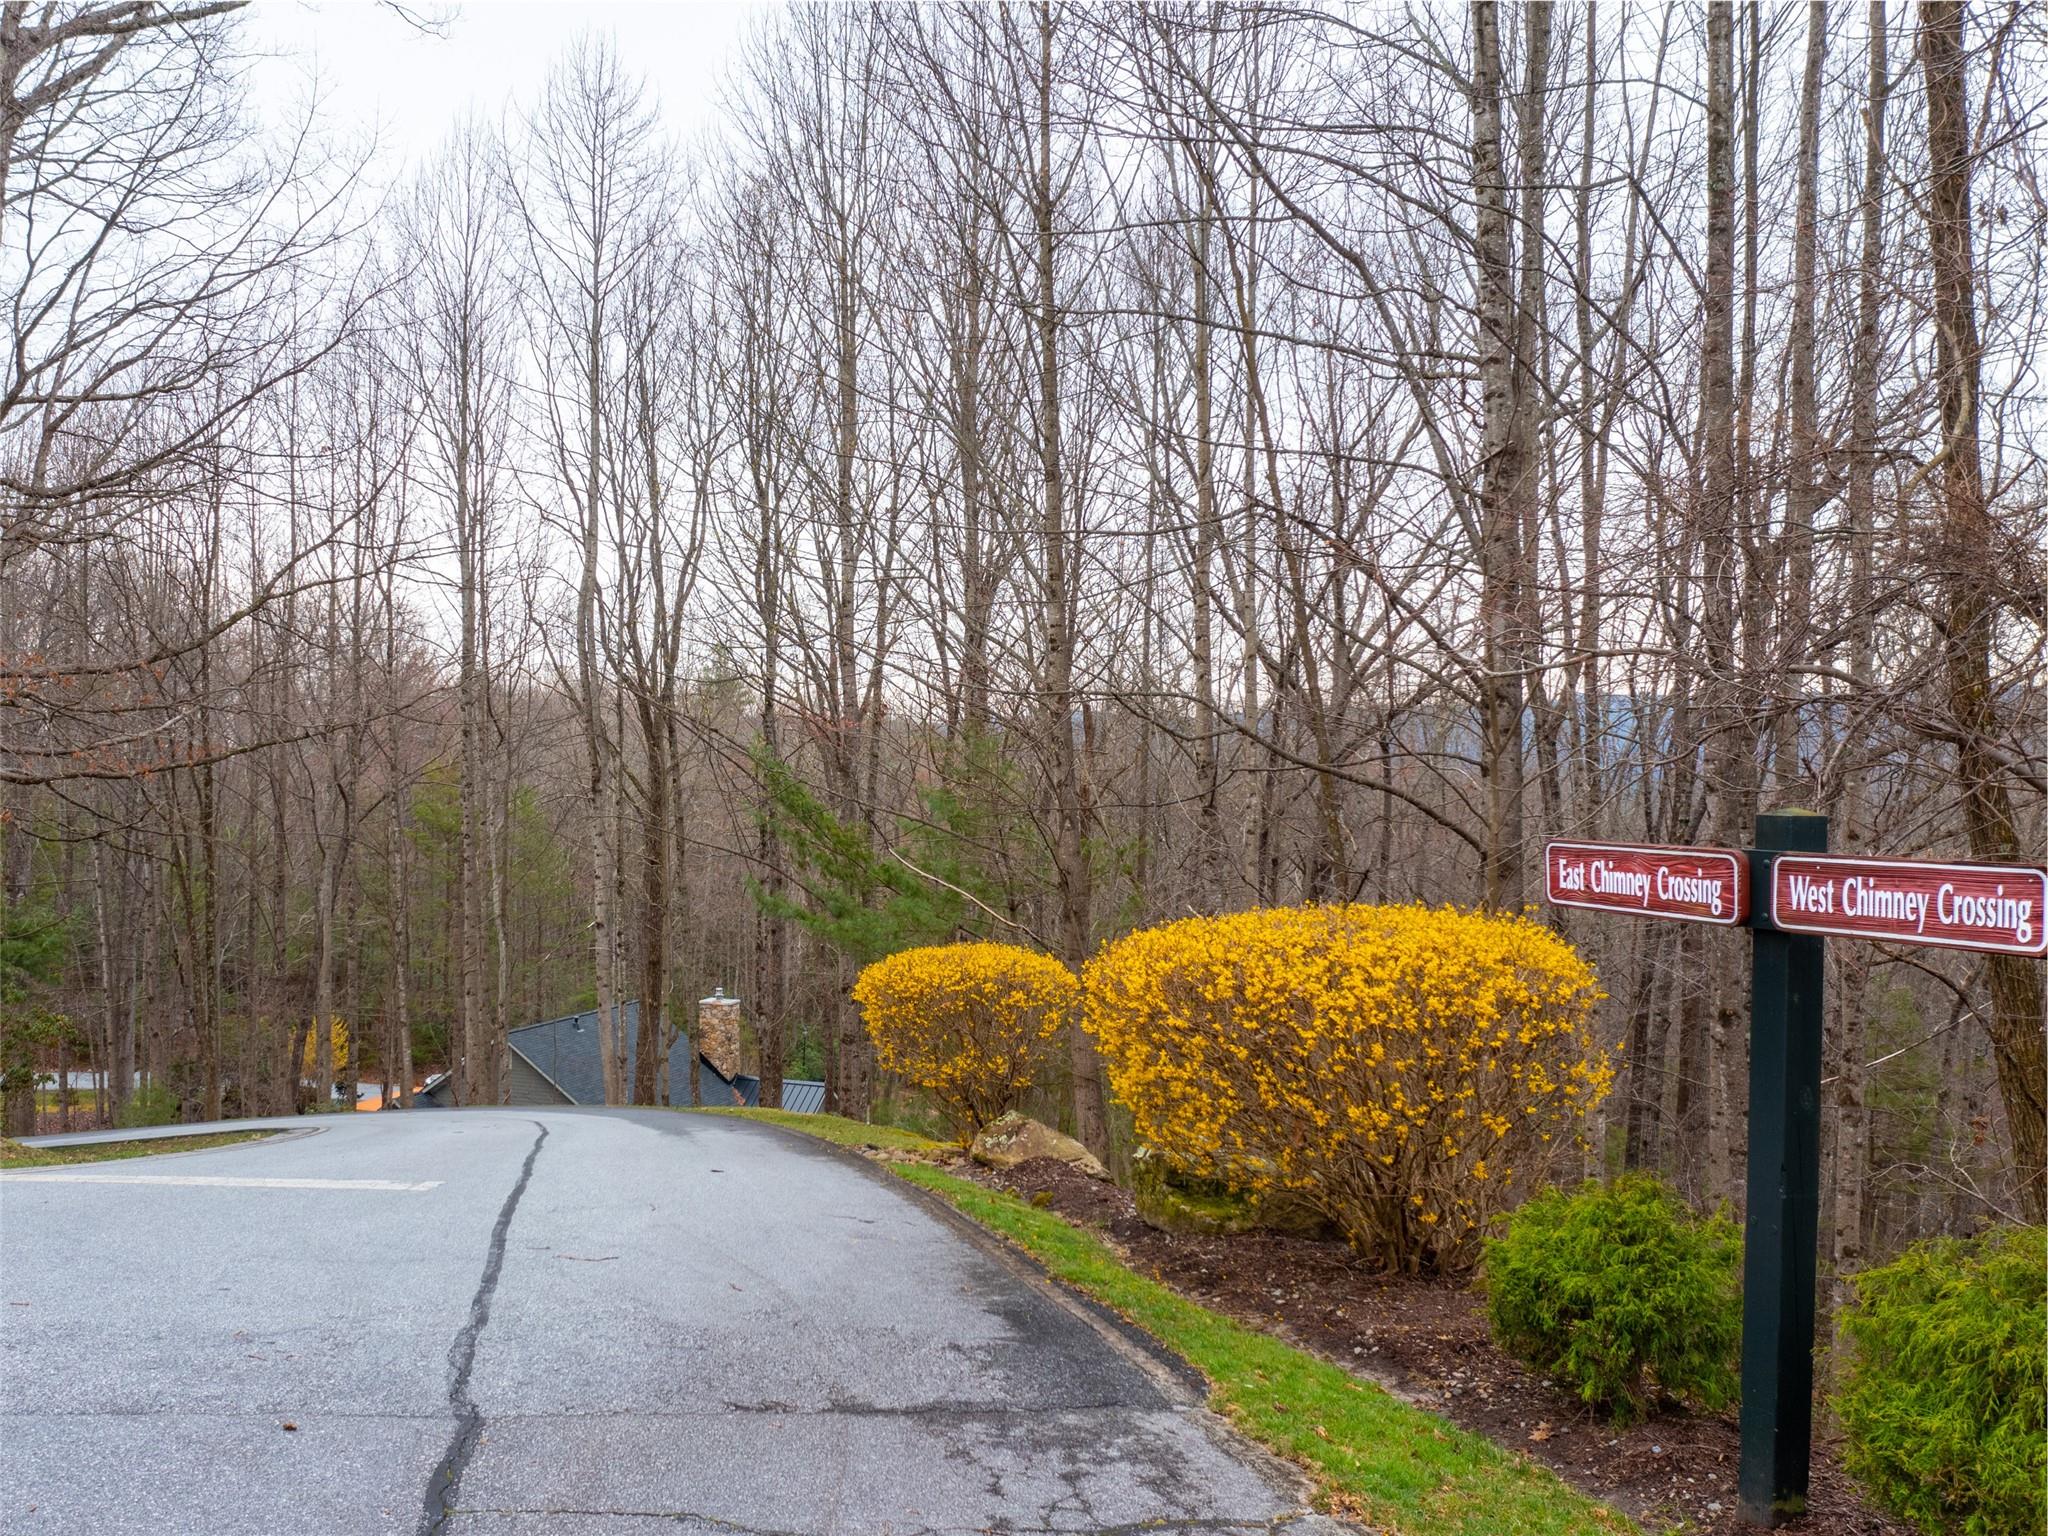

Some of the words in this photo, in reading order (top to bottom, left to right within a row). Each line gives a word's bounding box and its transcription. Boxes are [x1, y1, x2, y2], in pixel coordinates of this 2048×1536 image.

[1558, 858, 1585, 891] East
[1590, 860, 1651, 907] Chimney
[1657, 866, 1722, 915] Crossing
[1789, 875, 1834, 914] West
[1842, 876, 1929, 933] Chimney
[1937, 883, 2032, 943] Crossing
